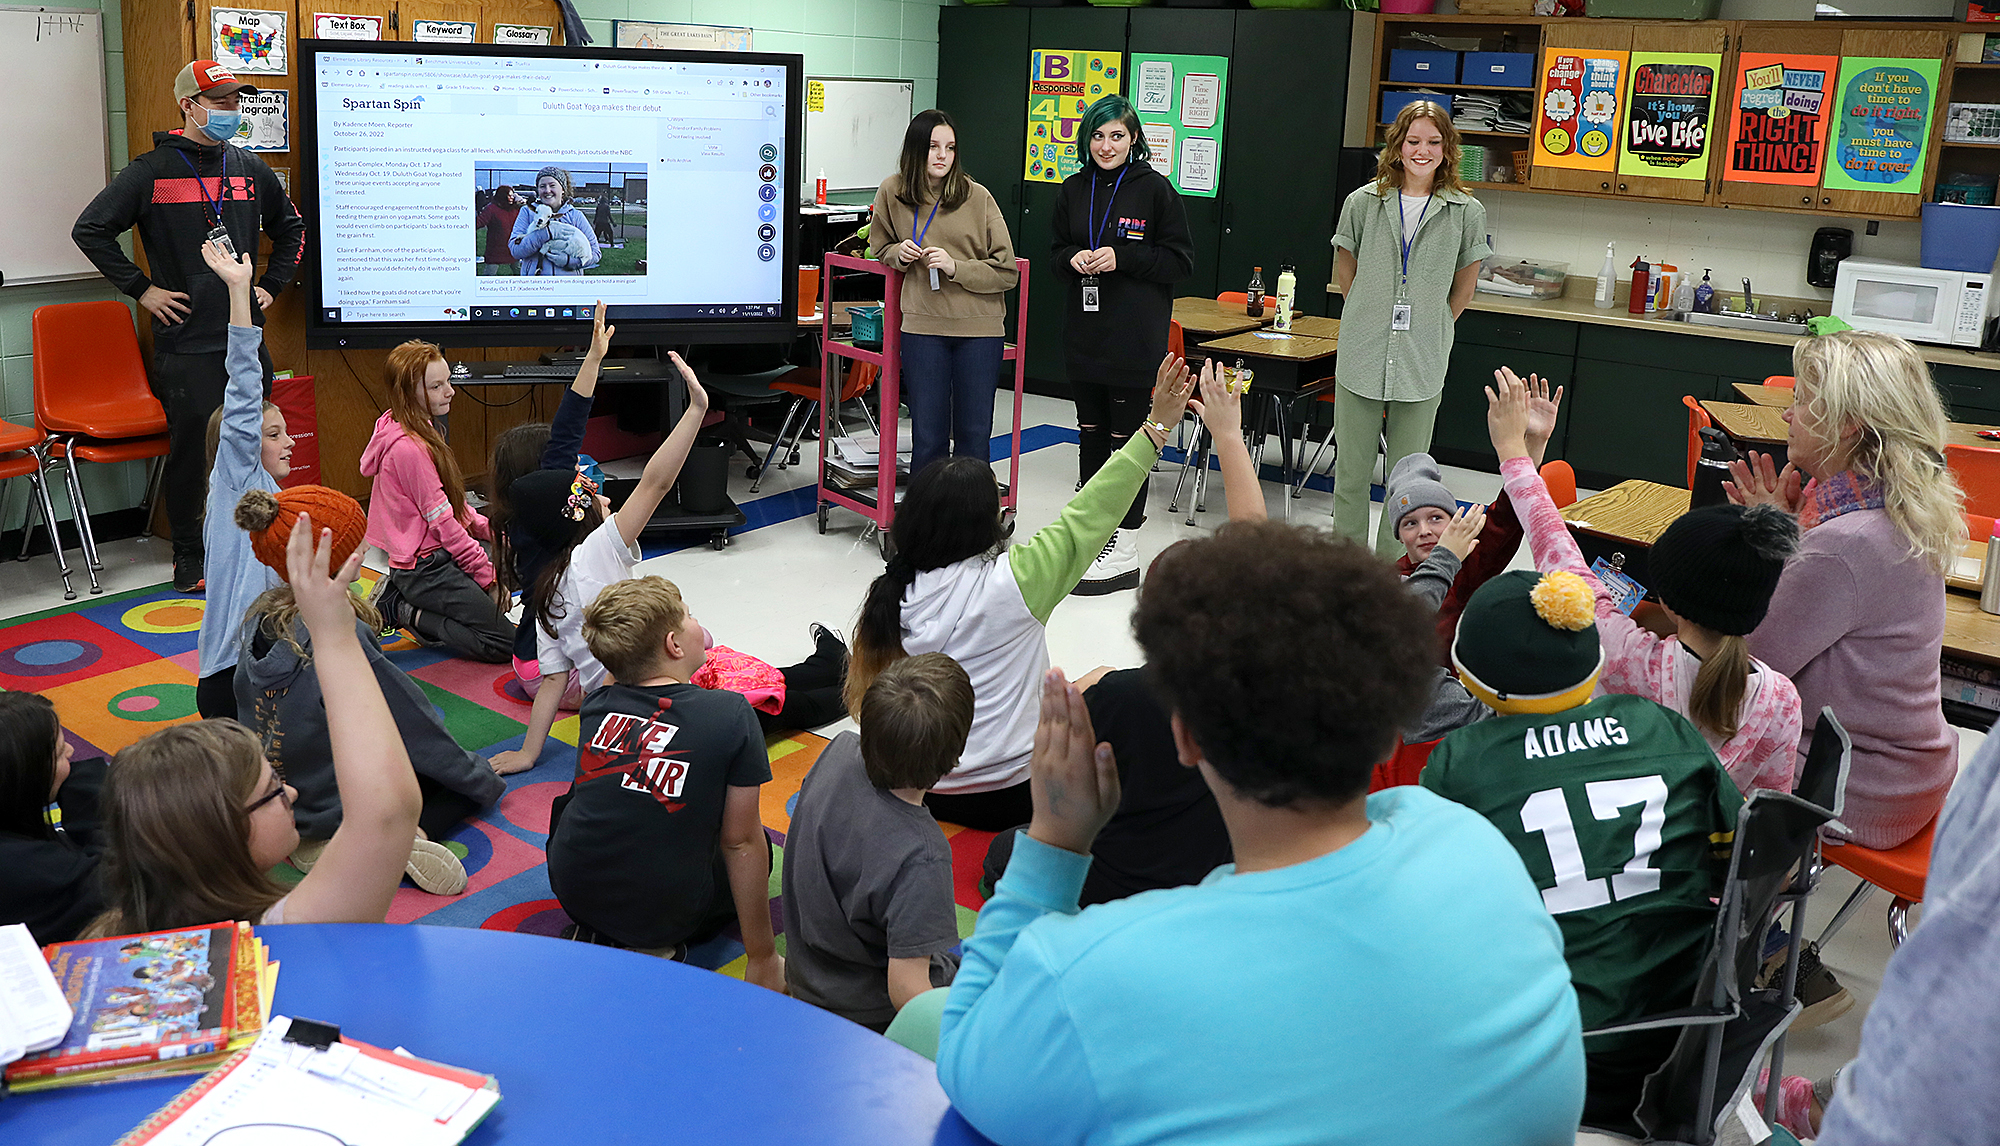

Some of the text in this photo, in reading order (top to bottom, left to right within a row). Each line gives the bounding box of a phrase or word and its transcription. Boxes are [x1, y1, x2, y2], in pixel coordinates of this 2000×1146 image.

[239, 16, 260, 27] Map
[330, 20, 366, 30] Text Box
[426, 25, 463, 35] Keyword
[506, 29, 539, 41] Glossary
[1044, 55, 1070, 79] B
[1549, 68, 1580, 80] change
[1590, 72, 1615, 82] think
[1749, 68, 1820, 88] You'll NEVER
[1875, 72, 1909, 84] If you
[1635, 66, 1712, 95] Character.
[1032, 82, 1085, 94] Responsible
[1860, 83, 1922, 94] don't have
[240, 94, 281, 104] tration &
[1144, 91, 1166, 104] Feel
[1192, 96, 1209, 106] Right
[1742, 91, 1820, 112] regret doing
[1867, 94, 1911, 105] time to
[342, 98, 422, 112] Spartan Spin
[542, 101, 565, 110] Duluth
[566, 102, 582, 110] Goat
[584, 102, 600, 112] Yoga
[602, 103, 624, 111] makes
[642, 104, 662, 112] debut
[1032, 99, 1058, 121] 4
[1648, 100, 1696, 112] It's how
[1656, 110, 1680, 123] you
[1772, 107, 1786, 117] the
[1851, 104, 1922, 120] do it right,
[1052, 120, 1081, 143] U
[1632, 116, 1704, 149] Live Life
[1740, 112, 1820, 142] RIGHT
[1872, 128, 1894, 137] you
[1850, 138, 1914, 149] must have
[1194, 152, 1204, 162] lift
[1736, 143, 1820, 172] THING!
[1859, 147, 1902, 159] time to
[1190, 165, 1206, 176] help
[1845, 158, 1911, 172] do it over.
[1118, 216, 1146, 230] PRIDE
[1116, 228, 1126, 238] IS
[594, 713, 671, 753] NIKE
[1524, 715, 1630, 760] ADAMS
[623, 760, 684, 796] AIR
[1519, 774, 1669, 915] 17
